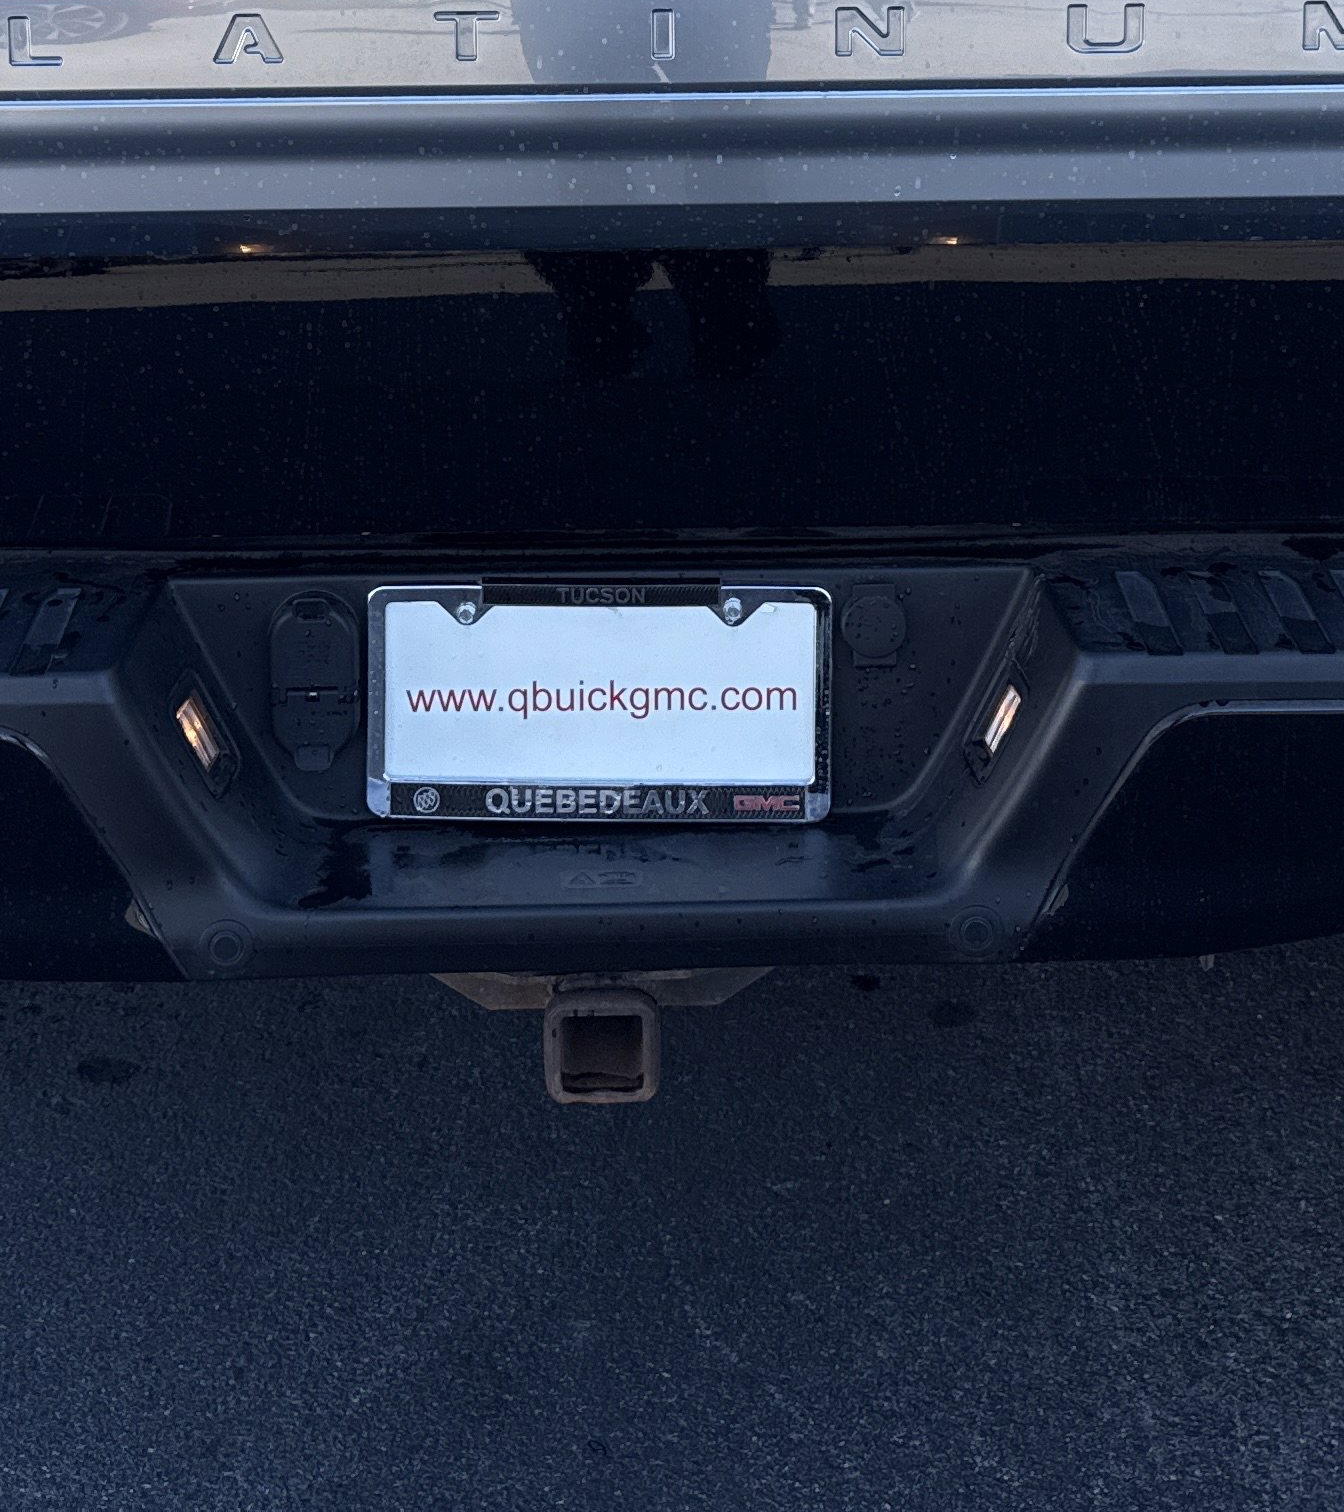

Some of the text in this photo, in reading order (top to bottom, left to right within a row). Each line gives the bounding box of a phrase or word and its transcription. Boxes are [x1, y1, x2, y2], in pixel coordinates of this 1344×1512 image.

[556, 587, 646, 604] TUCSON
[406, 679, 798, 720] www.qbuickgmc.com
[484, 787, 801, 816] QUEBEDEAUX GMC
